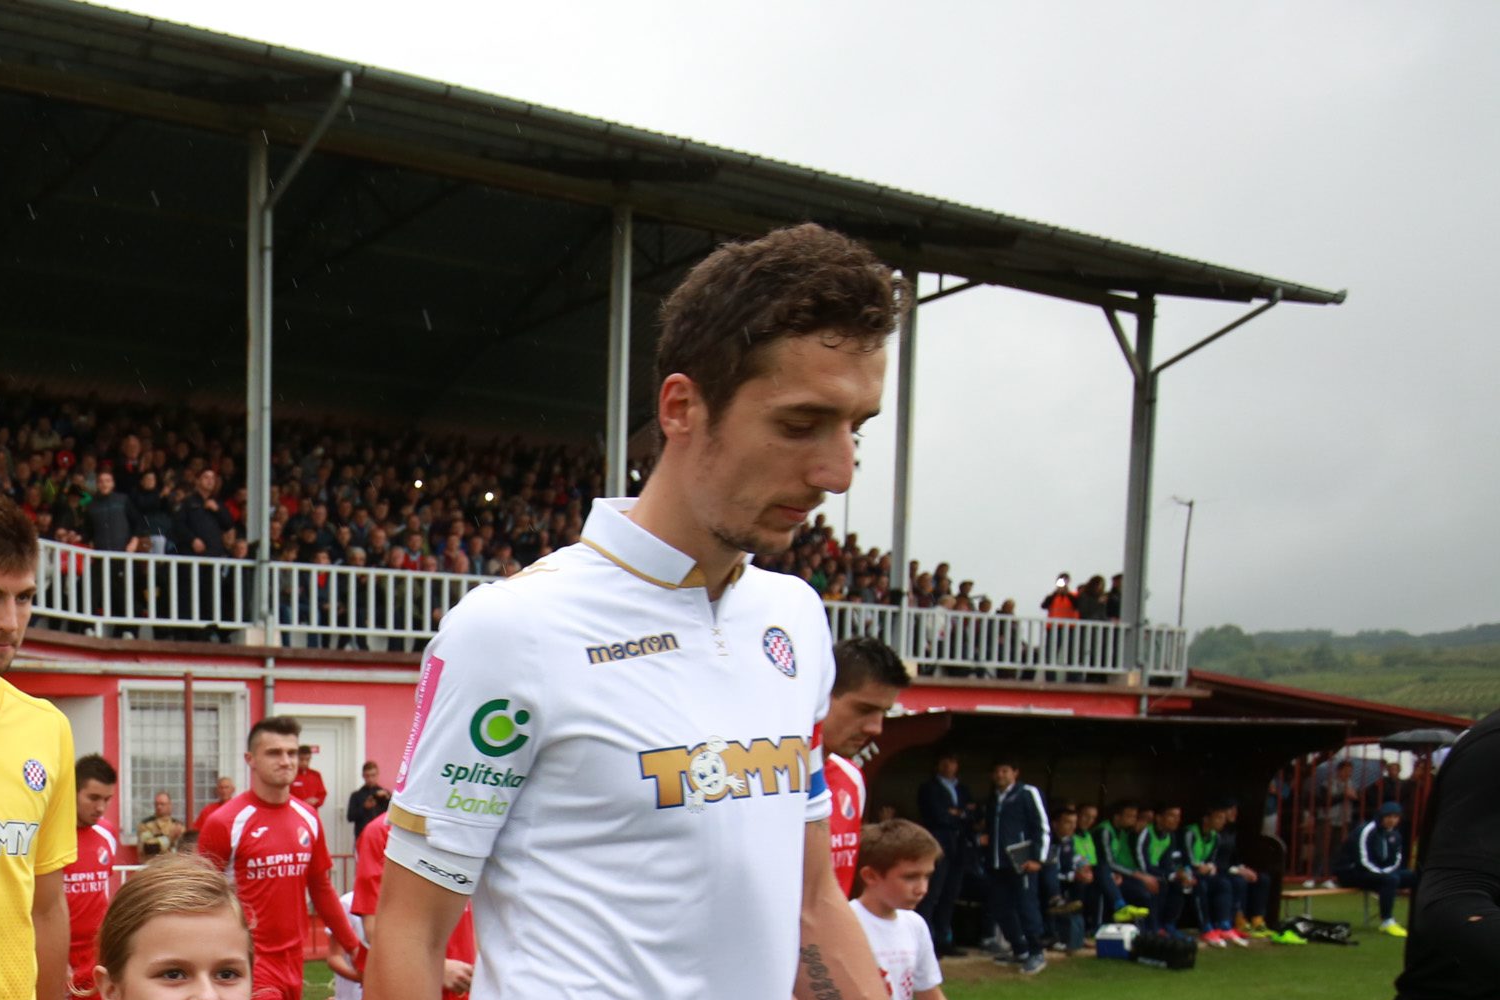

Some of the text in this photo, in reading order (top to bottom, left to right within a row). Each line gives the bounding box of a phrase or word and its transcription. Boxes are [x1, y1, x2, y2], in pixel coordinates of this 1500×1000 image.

[586, 632, 680, 665] macron
[441, 762, 527, 788] splitska
[246, 853, 294, 868] ALEPH
[62, 872, 95, 882] LEPH
